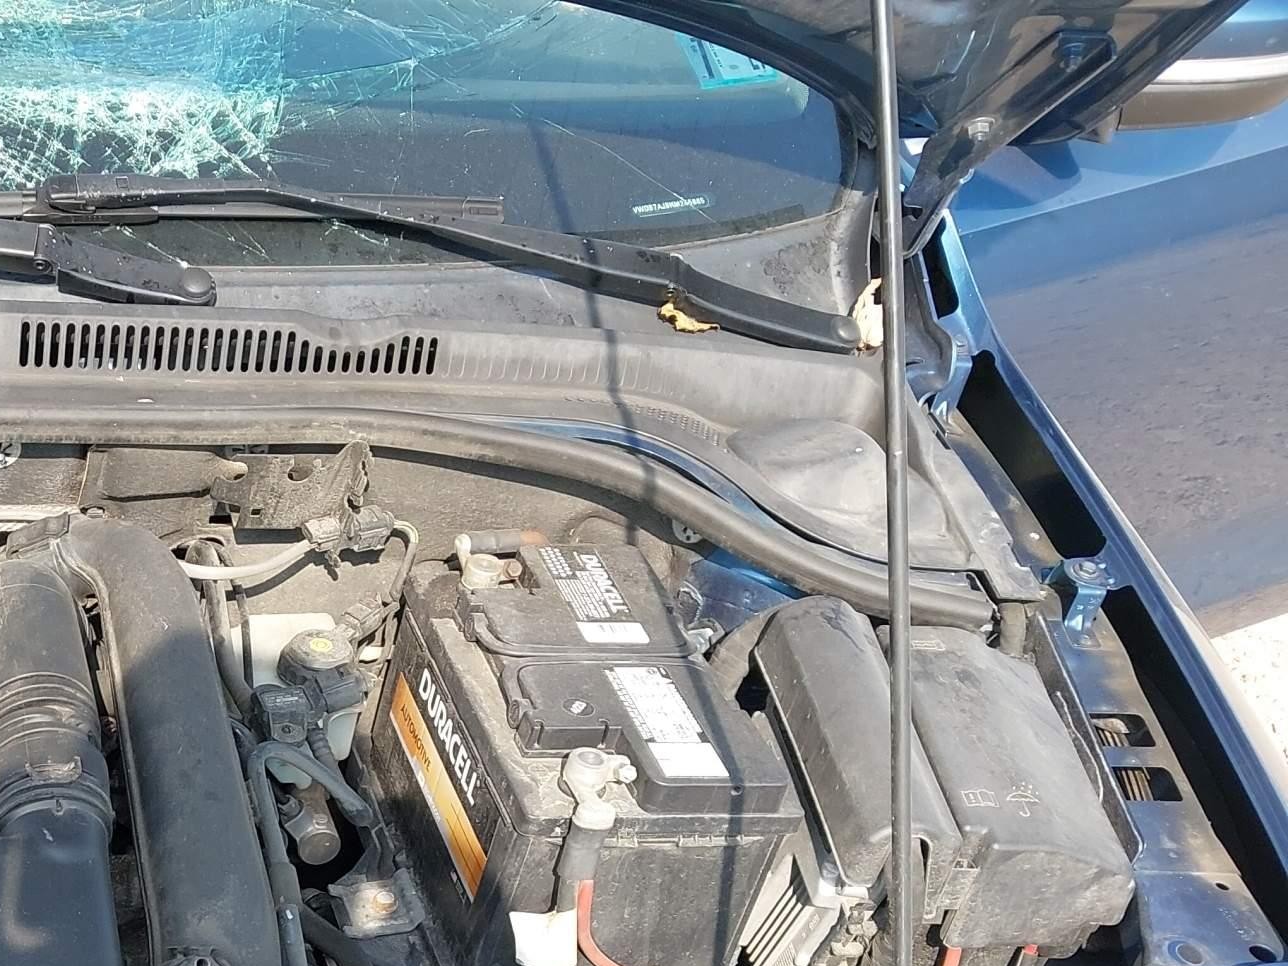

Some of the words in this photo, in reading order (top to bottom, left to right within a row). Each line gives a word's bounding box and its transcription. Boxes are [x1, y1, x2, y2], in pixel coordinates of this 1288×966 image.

[579, 554, 629, 614] DURACELL
[400, 703, 432, 773] AUTOMOTIVE
[419, 668, 477, 807] DURACELL
